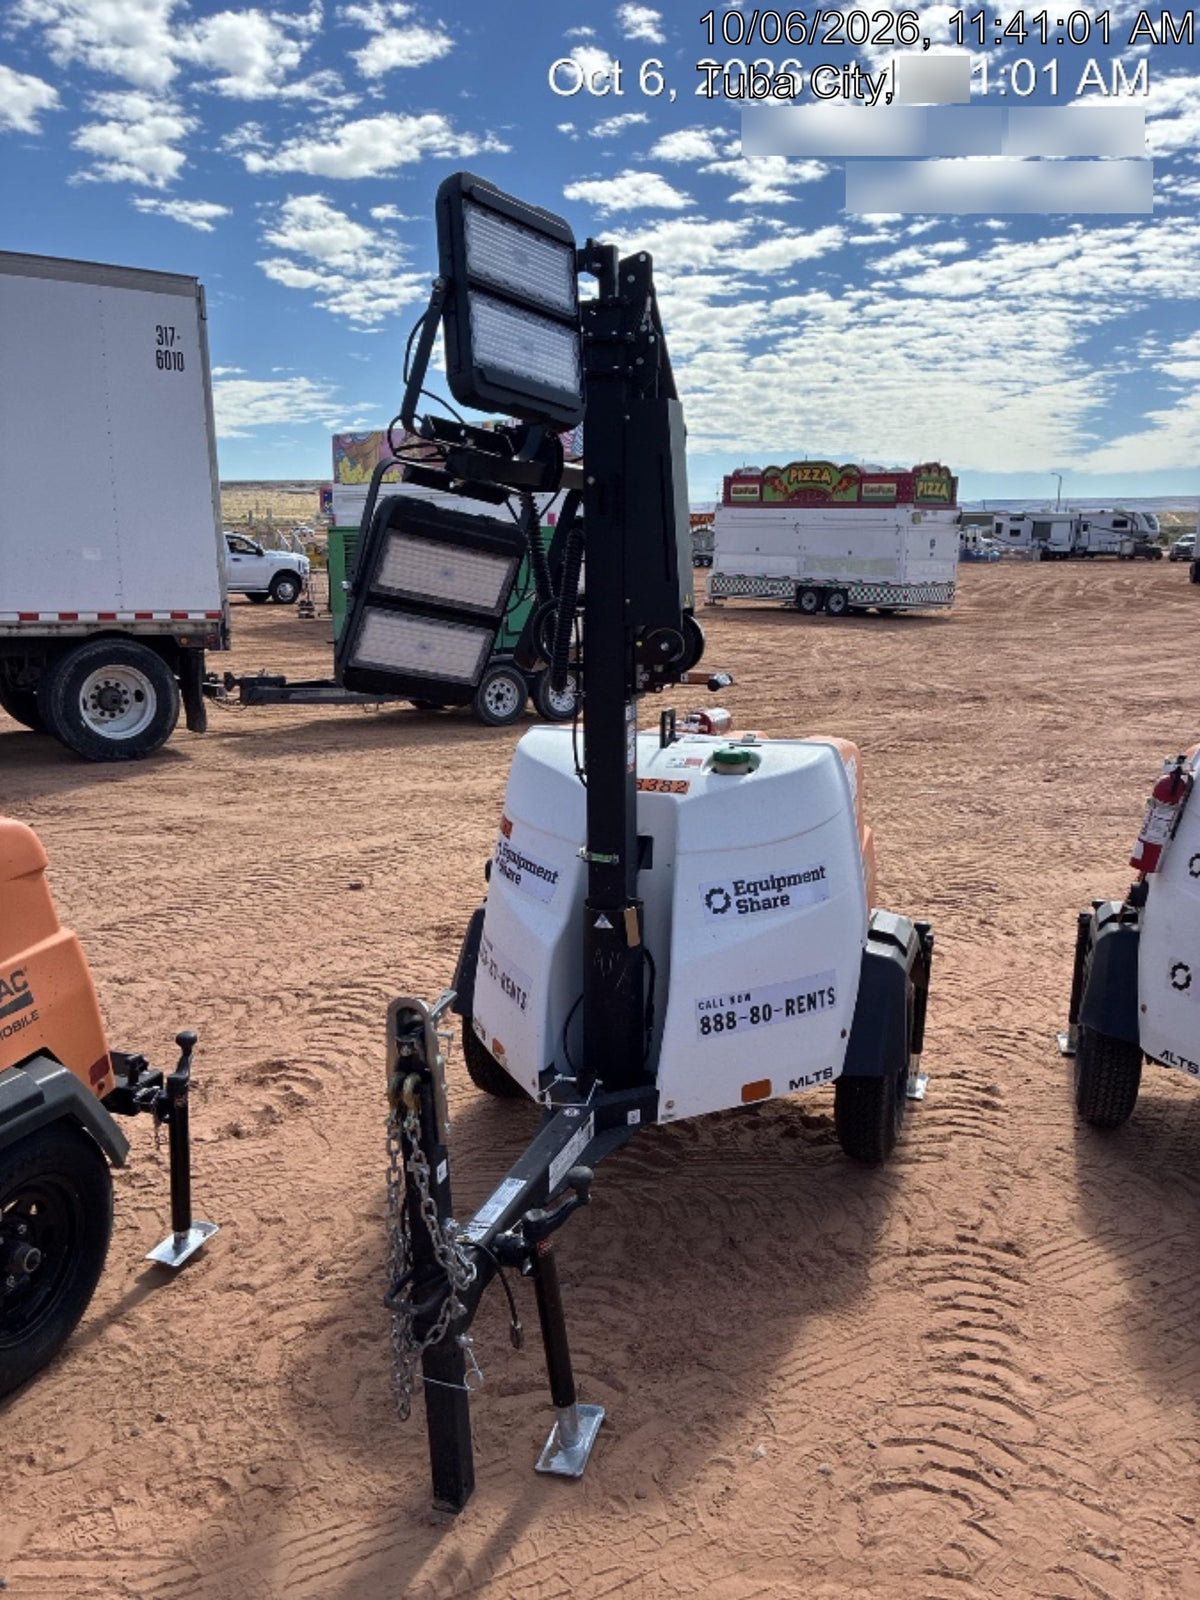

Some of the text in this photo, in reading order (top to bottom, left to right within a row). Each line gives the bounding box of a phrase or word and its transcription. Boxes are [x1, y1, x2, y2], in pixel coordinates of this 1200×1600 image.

[155, 349, 186, 373] 6010
[788, 467, 833, 484] PIZZA
[917, 480, 949, 501] PIZZA
[732, 865, 826, 897] Equipment
[735, 893, 791, 915] Share
[698, 997, 725, 1011] CALL
[699, 985, 837, 1036] 888-80-RENTS
